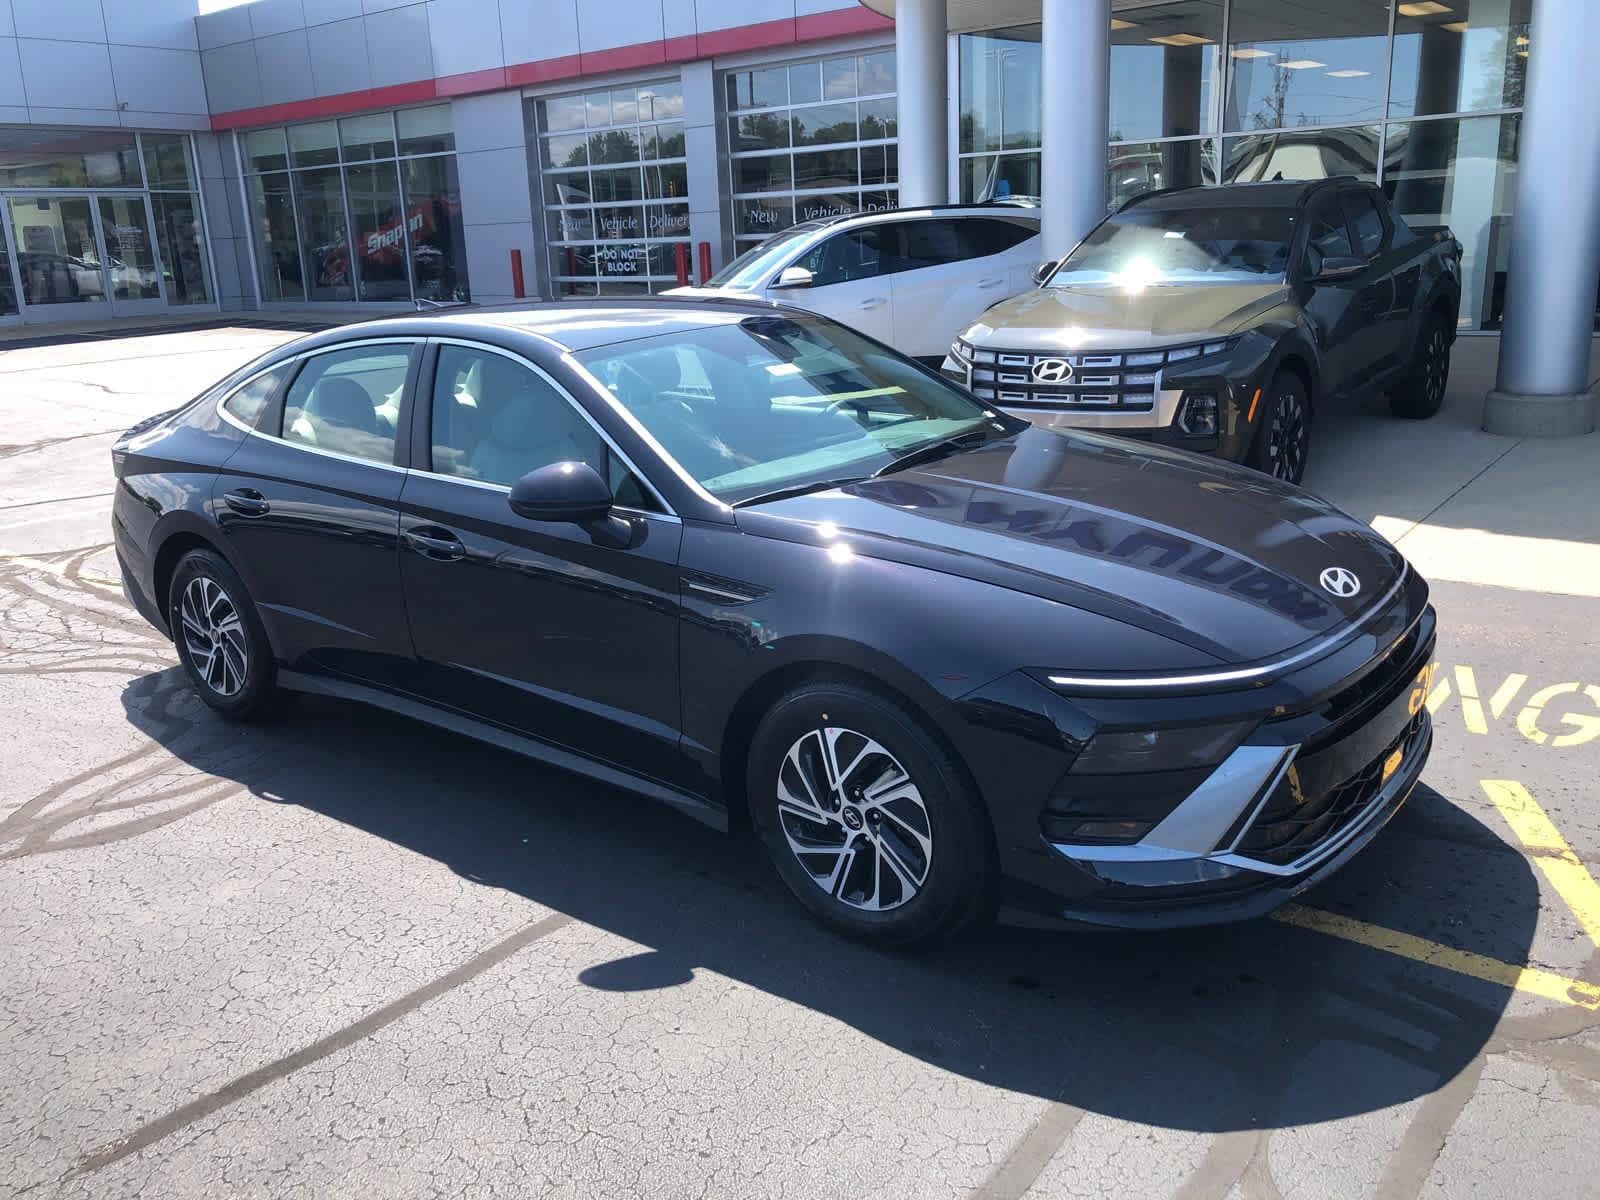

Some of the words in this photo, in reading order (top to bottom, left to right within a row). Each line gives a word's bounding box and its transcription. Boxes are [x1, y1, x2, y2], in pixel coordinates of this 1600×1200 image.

[599, 215, 638, 231] Vehicle
[649, 212, 688, 229] Deliver
[750, 209, 779, 224] New
[803, 204, 852, 220] Vehicle
[603, 248, 618, 260] DO
[620, 247, 641, 261] NOT
[606, 261, 638, 273] BLOCK
[1424, 661, 1600, 747] NG
